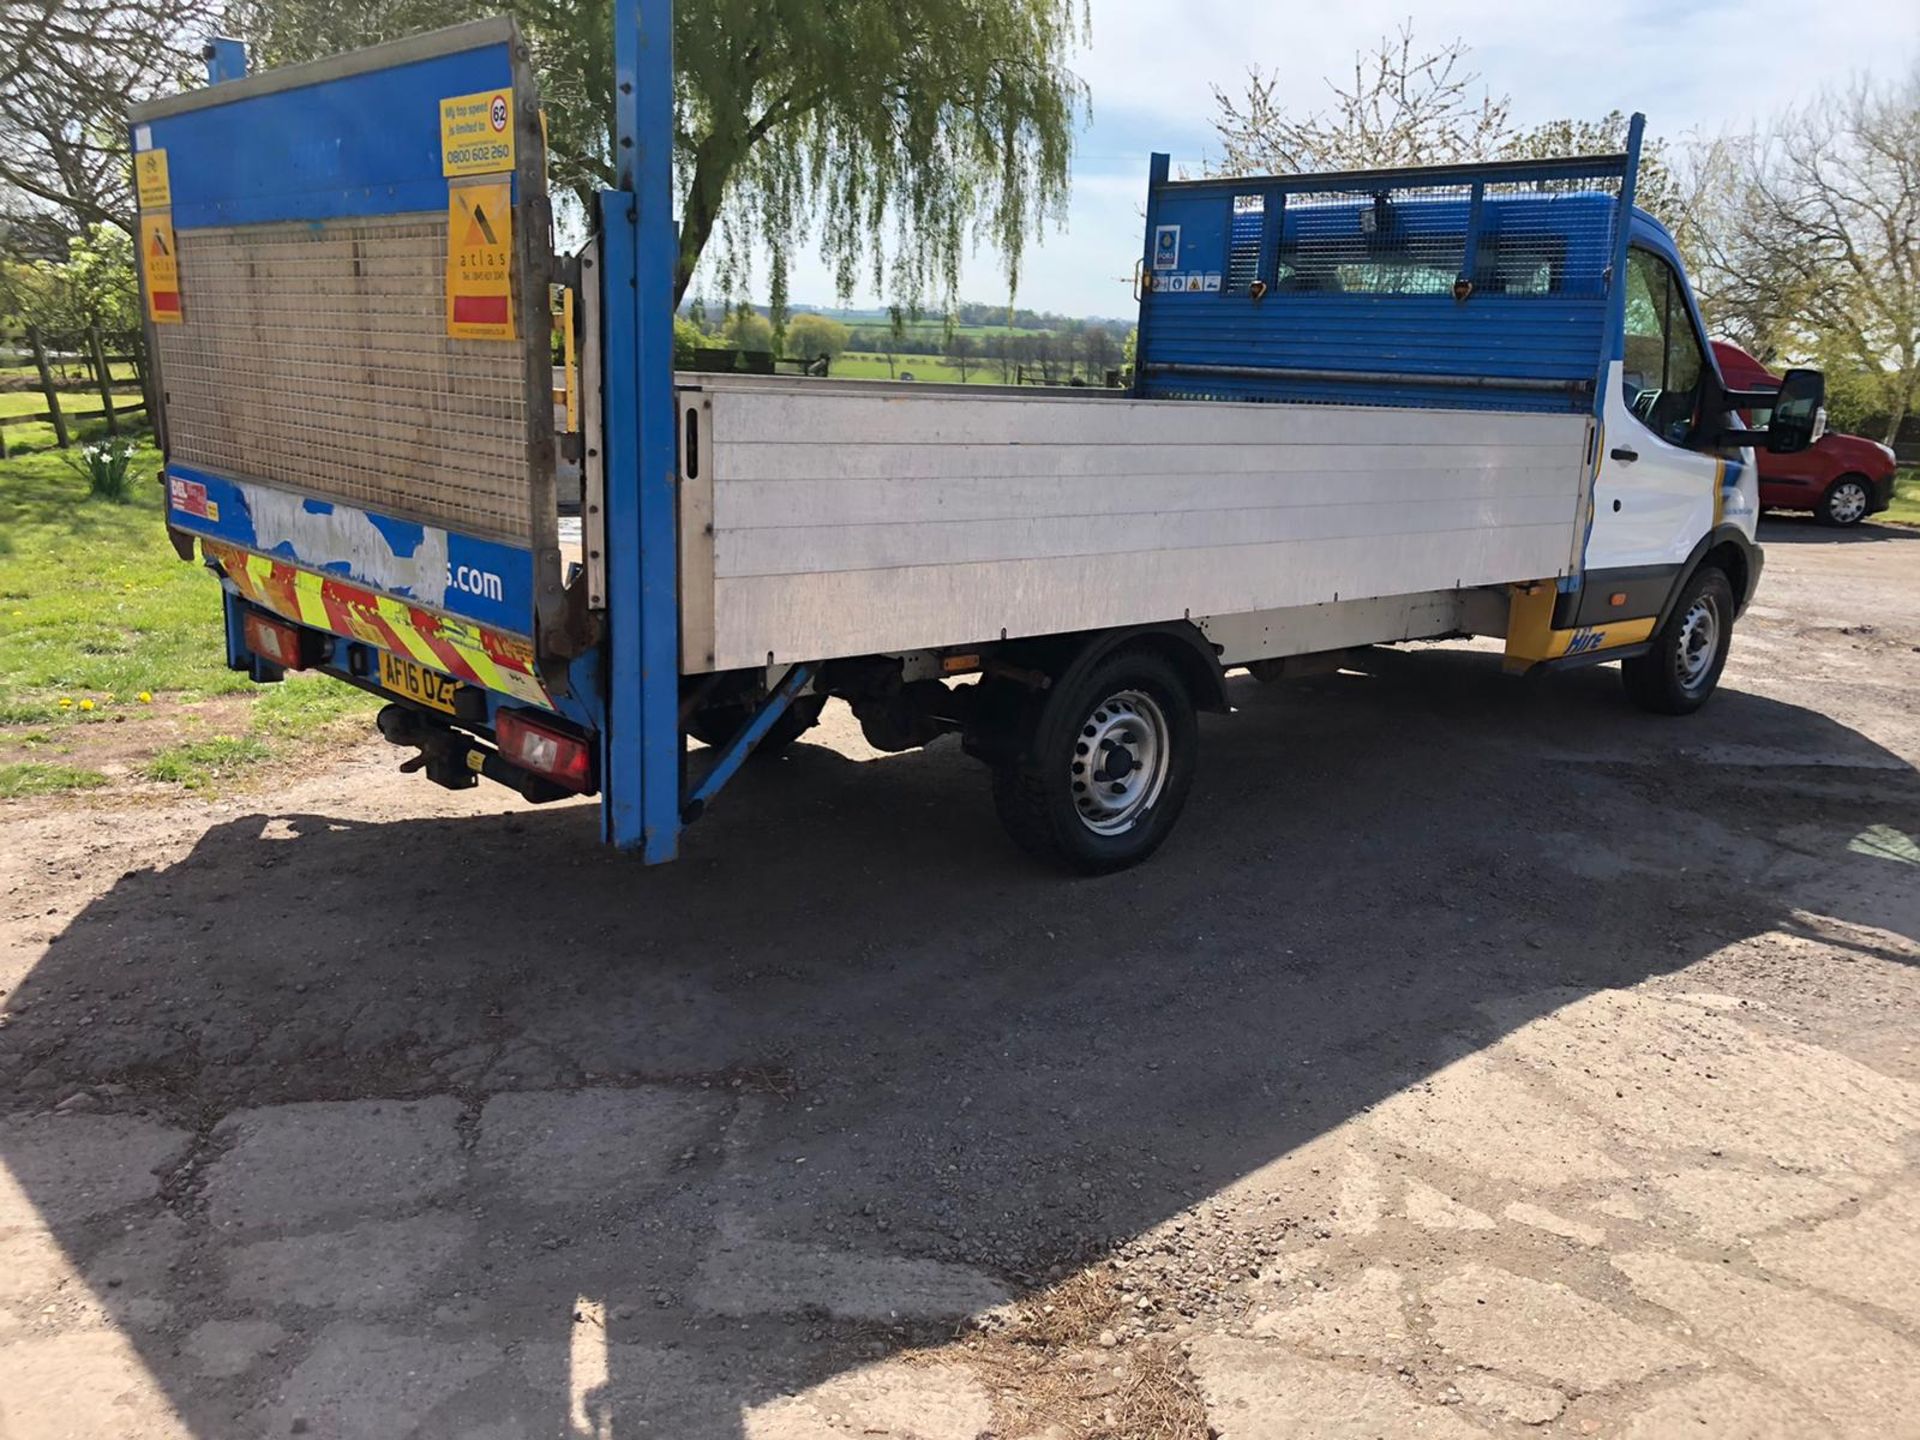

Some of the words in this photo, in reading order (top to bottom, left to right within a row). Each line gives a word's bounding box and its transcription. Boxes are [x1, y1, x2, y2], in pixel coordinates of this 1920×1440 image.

[445, 106, 455, 119] My
[456, 105, 467, 117] top
[469, 101, 488, 115] speed
[493, 105, 505, 122] 62
[456, 122, 477, 134] limited
[479, 121, 486, 131] to
[447, 149, 470, 164] 0800
[472, 147, 489, 161] 602
[491, 144, 509, 160] 260
[460, 247, 505, 267] atlas
[386, 653, 419, 694] AF16
